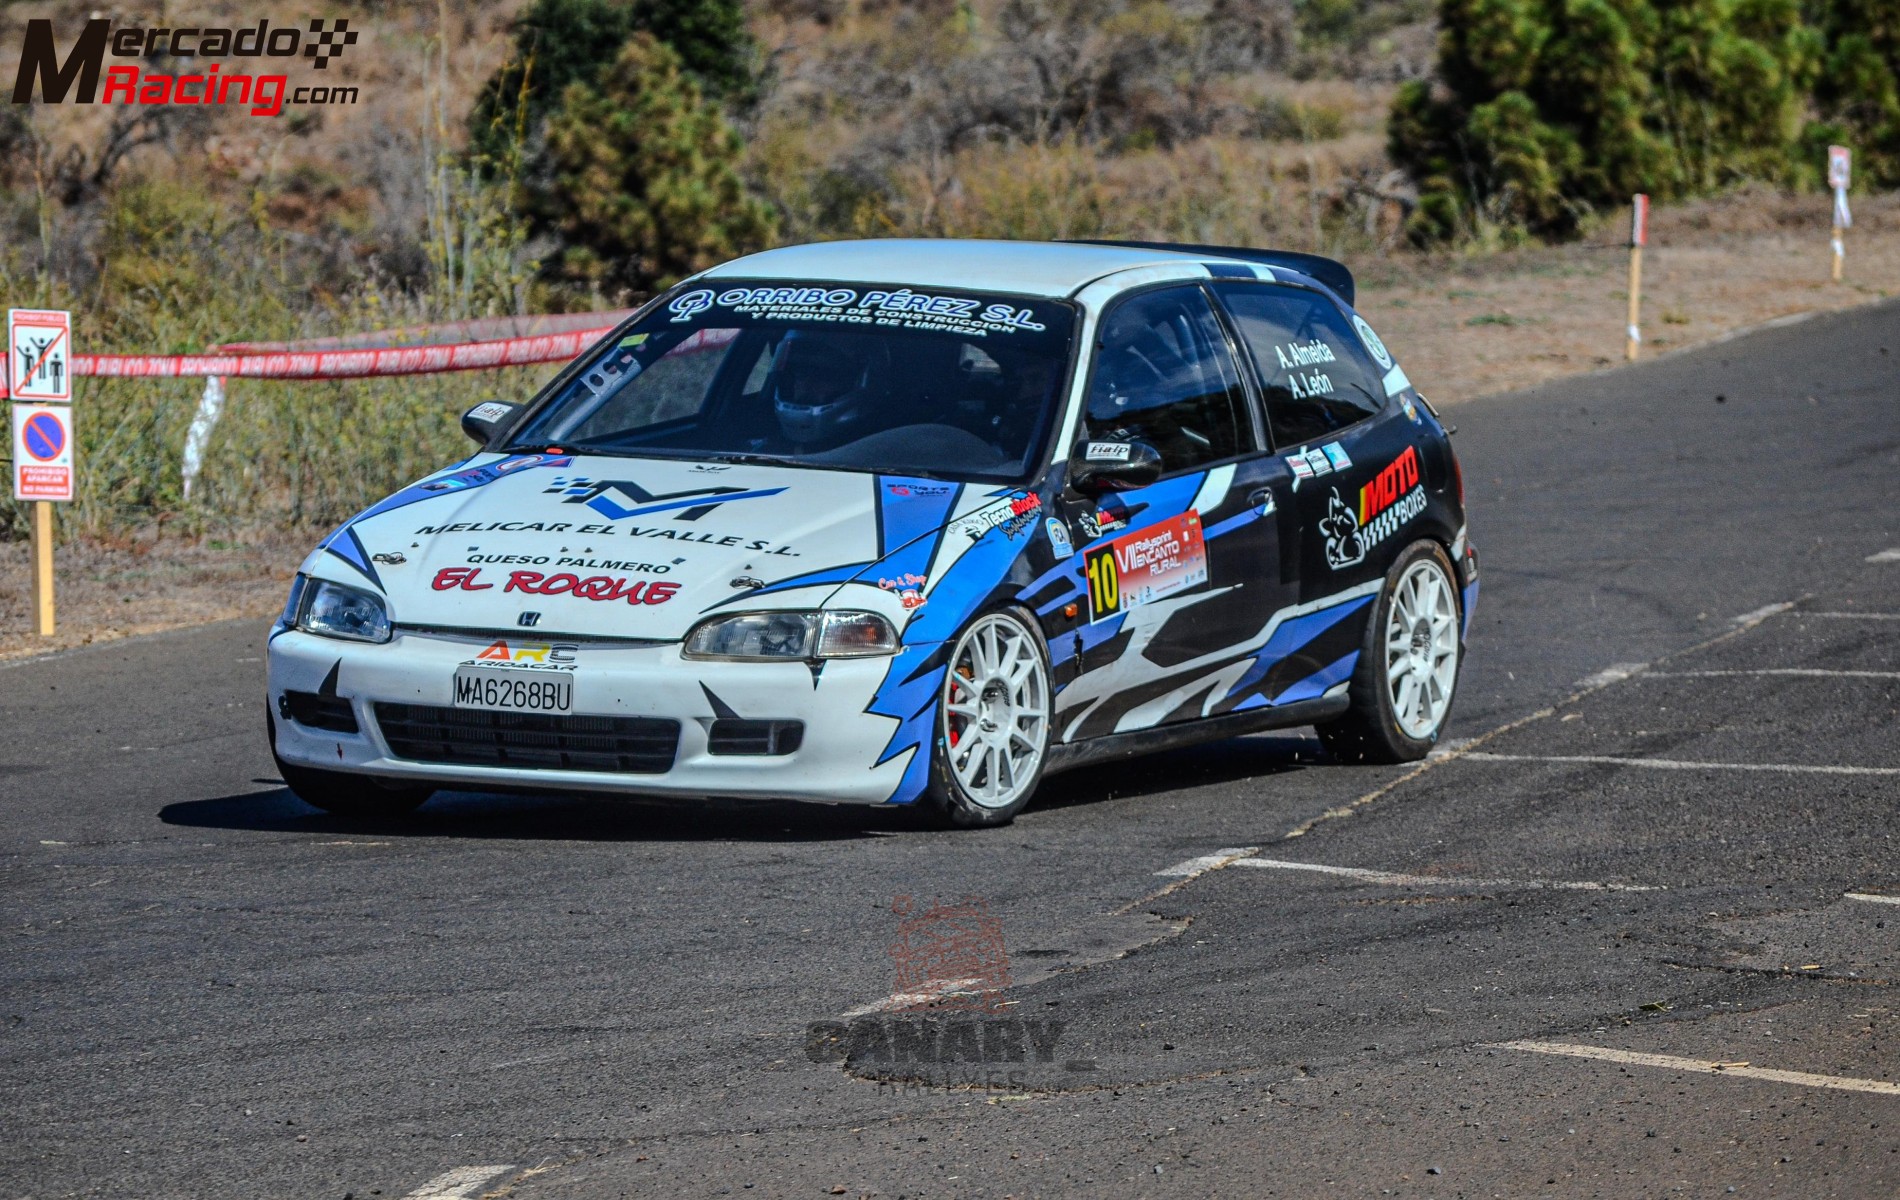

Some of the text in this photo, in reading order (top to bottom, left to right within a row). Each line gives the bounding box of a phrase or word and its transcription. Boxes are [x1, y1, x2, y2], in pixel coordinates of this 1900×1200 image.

[717, 287, 1046, 331] ORRIBO PÉREZ S.L.
[734, 304, 1016, 333] MATERIALES DE CONSTRUCCION
[765, 312, 873, 324] PRODUCTOS
[876, 317, 902, 326] DE
[903, 321, 987, 337] LIMPIEZA
[1275, 339, 1336, 369] A. Almeida
[1289, 368, 1334, 400] A. León
[1089, 443, 1129, 456] fialp
[1363, 444, 1419, 524] MOTO
[979, 490, 1041, 528] Tecnoshock
[1400, 484, 1428, 524] BOXES
[415, 522, 800, 557] MELICAR EL VALLE S.L.
[1136, 540, 1180, 568] ENCANTO
[466, 554, 671, 574] QUESO PALMERO
[1115, 543, 1137, 573] VII
[1150, 555, 1182, 577] RURAL
[432, 567, 682, 606] EL ROQUE
[1089, 552, 1118, 614] 10
[458, 660, 579, 671] ARIDACAR
[476, 639, 579, 664] ARC
[456, 676, 571, 711] MA6268BU
